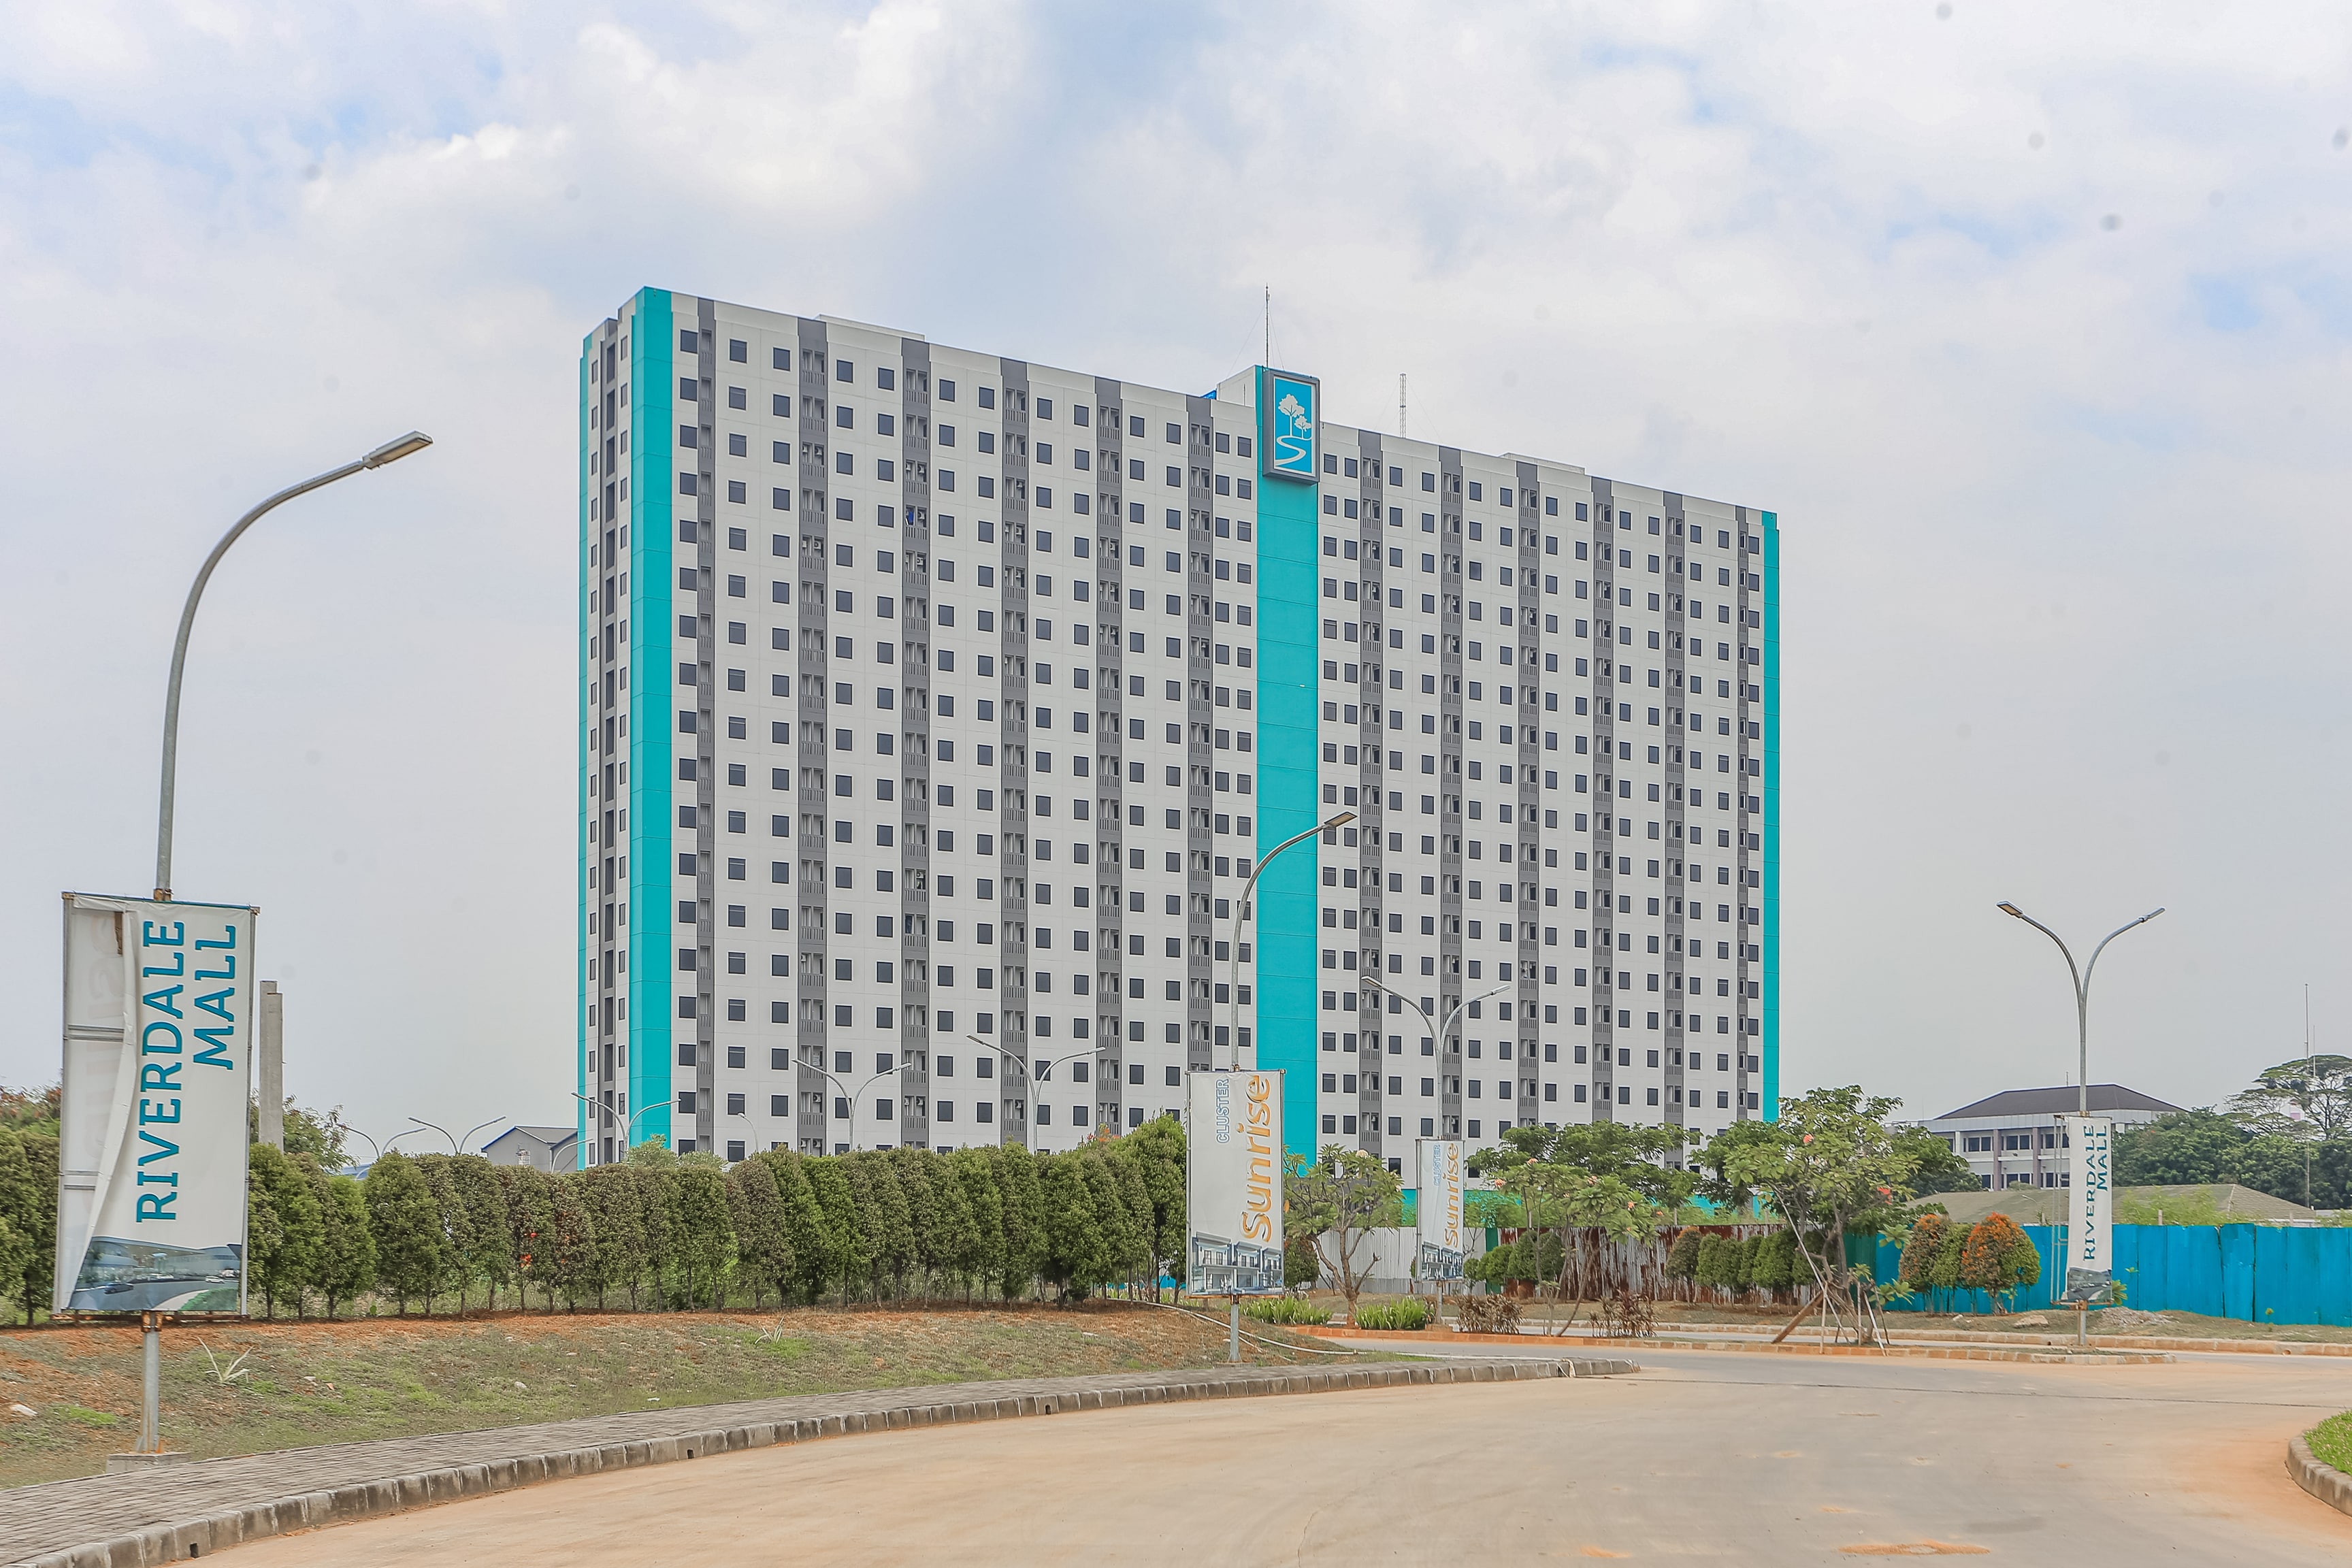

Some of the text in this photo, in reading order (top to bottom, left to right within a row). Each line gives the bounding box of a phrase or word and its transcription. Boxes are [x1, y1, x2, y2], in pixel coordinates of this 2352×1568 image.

[193, 924, 236, 1071] MALL
[137, 921, 185, 1222] RIVERDALE
[1216, 1079, 1230, 1143] CLUSTER
[1235, 1075, 1272, 1243] Sunrise
[1442, 1143, 1458, 1248] Sunrise
[2083, 1125, 2096, 1261] RIVERDALE
[2097, 1125, 2108, 1192] MALL
